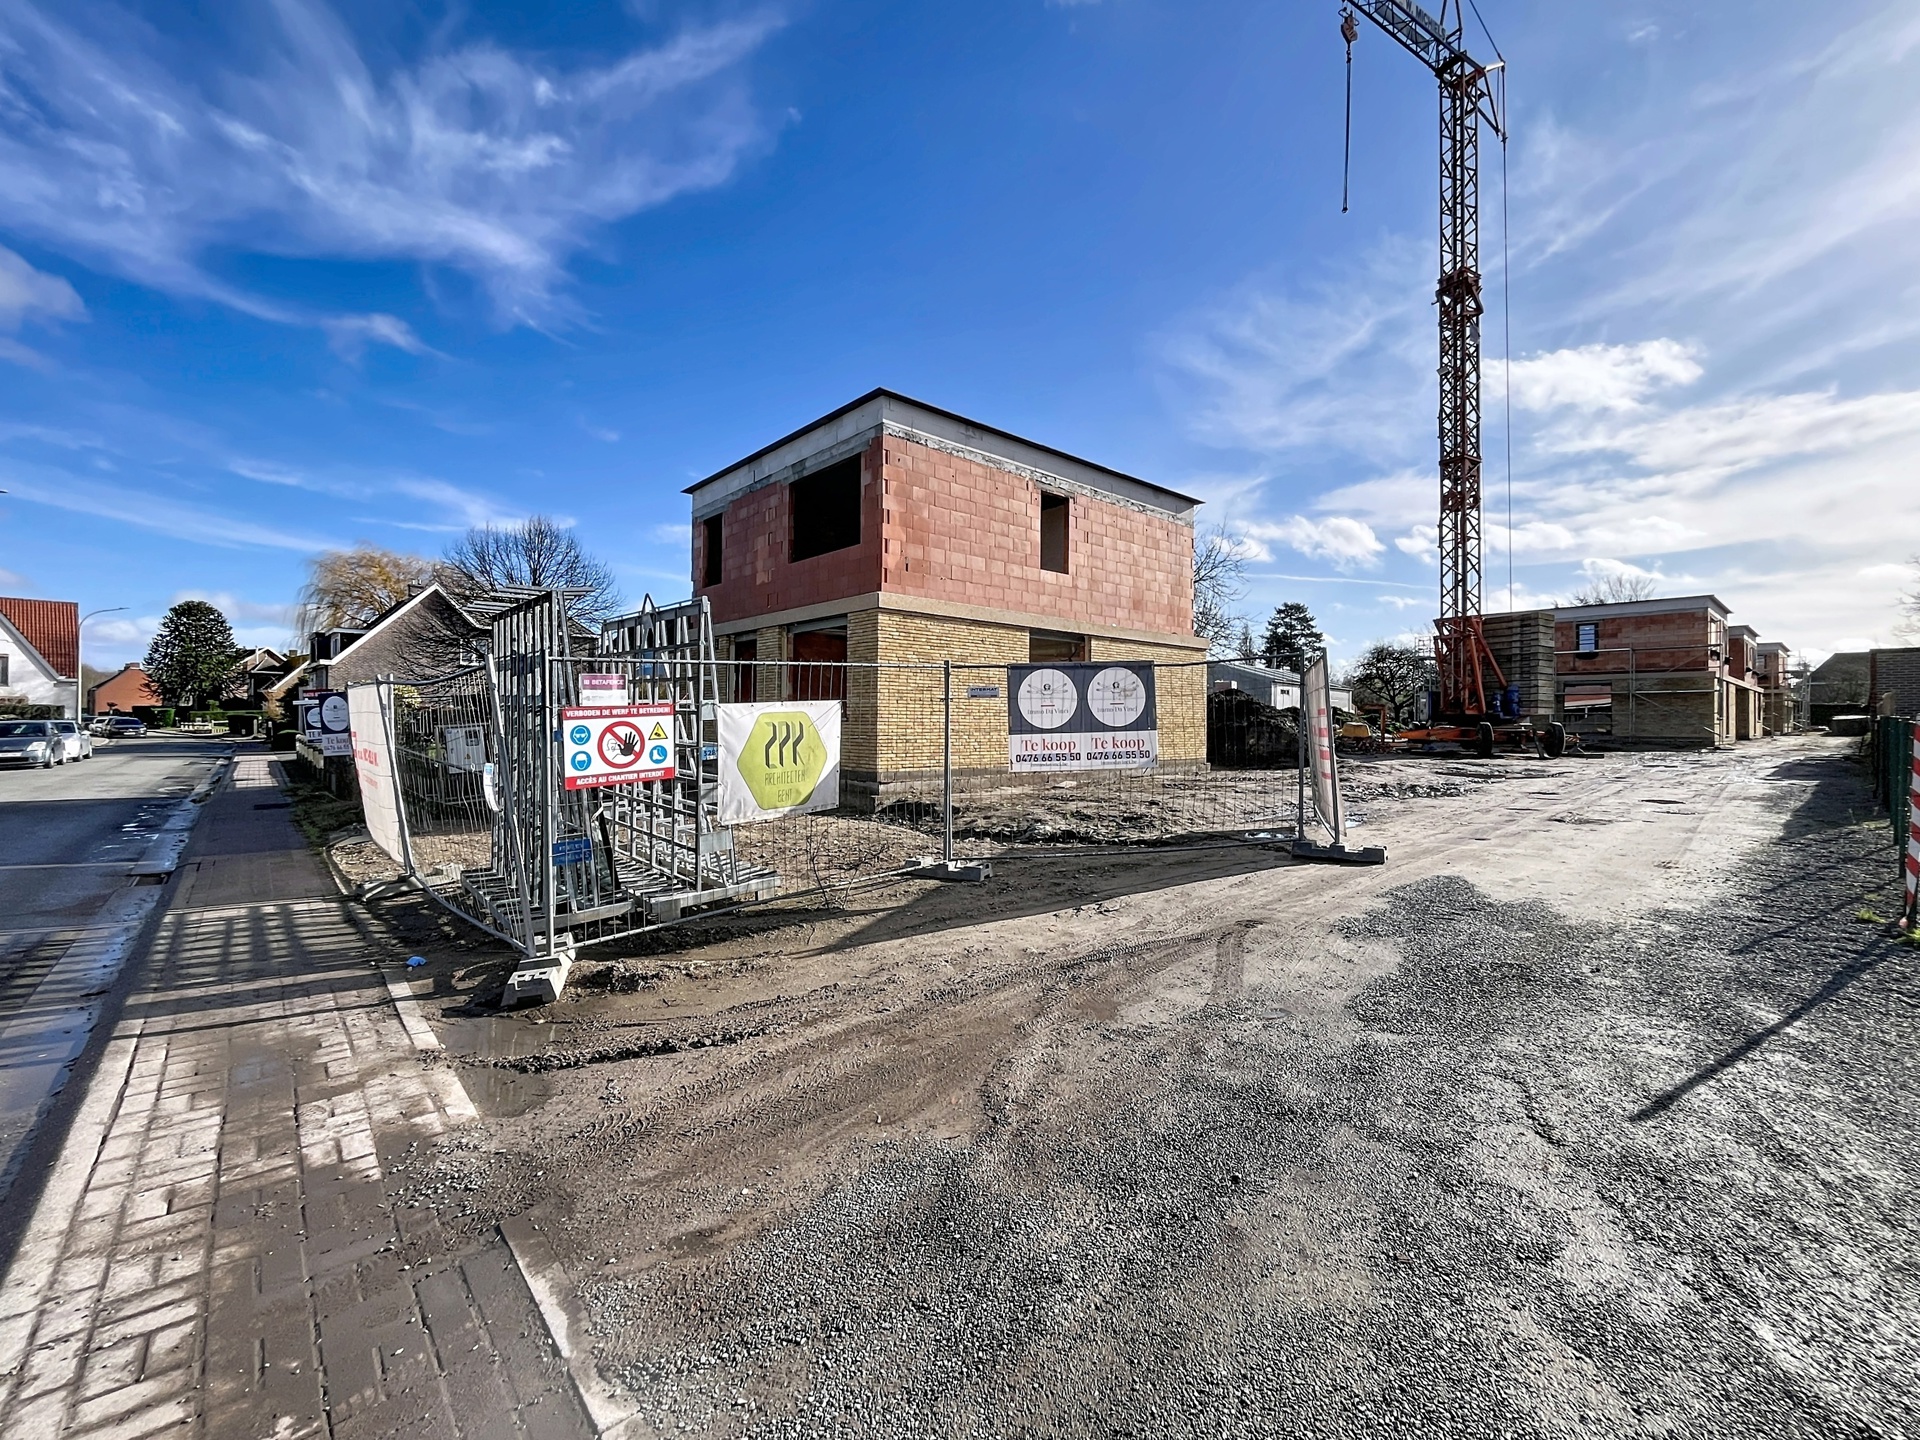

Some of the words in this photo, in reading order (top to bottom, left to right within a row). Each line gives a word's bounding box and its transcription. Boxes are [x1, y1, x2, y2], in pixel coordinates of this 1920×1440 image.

[1415, 4, 1446, 41] MICHIELS
[565, 709, 601, 717] VERBODEN
[612, 708, 630, 716] WERF
[630, 707, 638, 715] TE
[639, 706, 671, 714] BETREDEN!
[326, 737, 335, 745] Te
[1021, 739, 1038, 752] Te
[1042, 738, 1076, 752] koop
[1091, 737, 1108, 750] Te
[1112, 736, 1145, 750] koop
[1015, 753, 1039, 763] 0476
[1041, 753, 1053, 762] 66
[1055, 752, 1067, 762] 55
[1069, 752, 1081, 761] 50
[1086, 751, 1110, 761] 0476
[1111, 751, 1123, 760] 66
[1125, 750, 1137, 759] 55
[1139, 750, 1151, 759] 50
[576, 776, 597, 785] ACCÈS
[597, 775, 607, 783] AU
[608, 772, 638, 781] CHANTIER
[639, 770, 665, 778] INTERDIT
[764, 769, 806, 786] ARCHITECTEN
[777, 788, 793, 803] GENT
